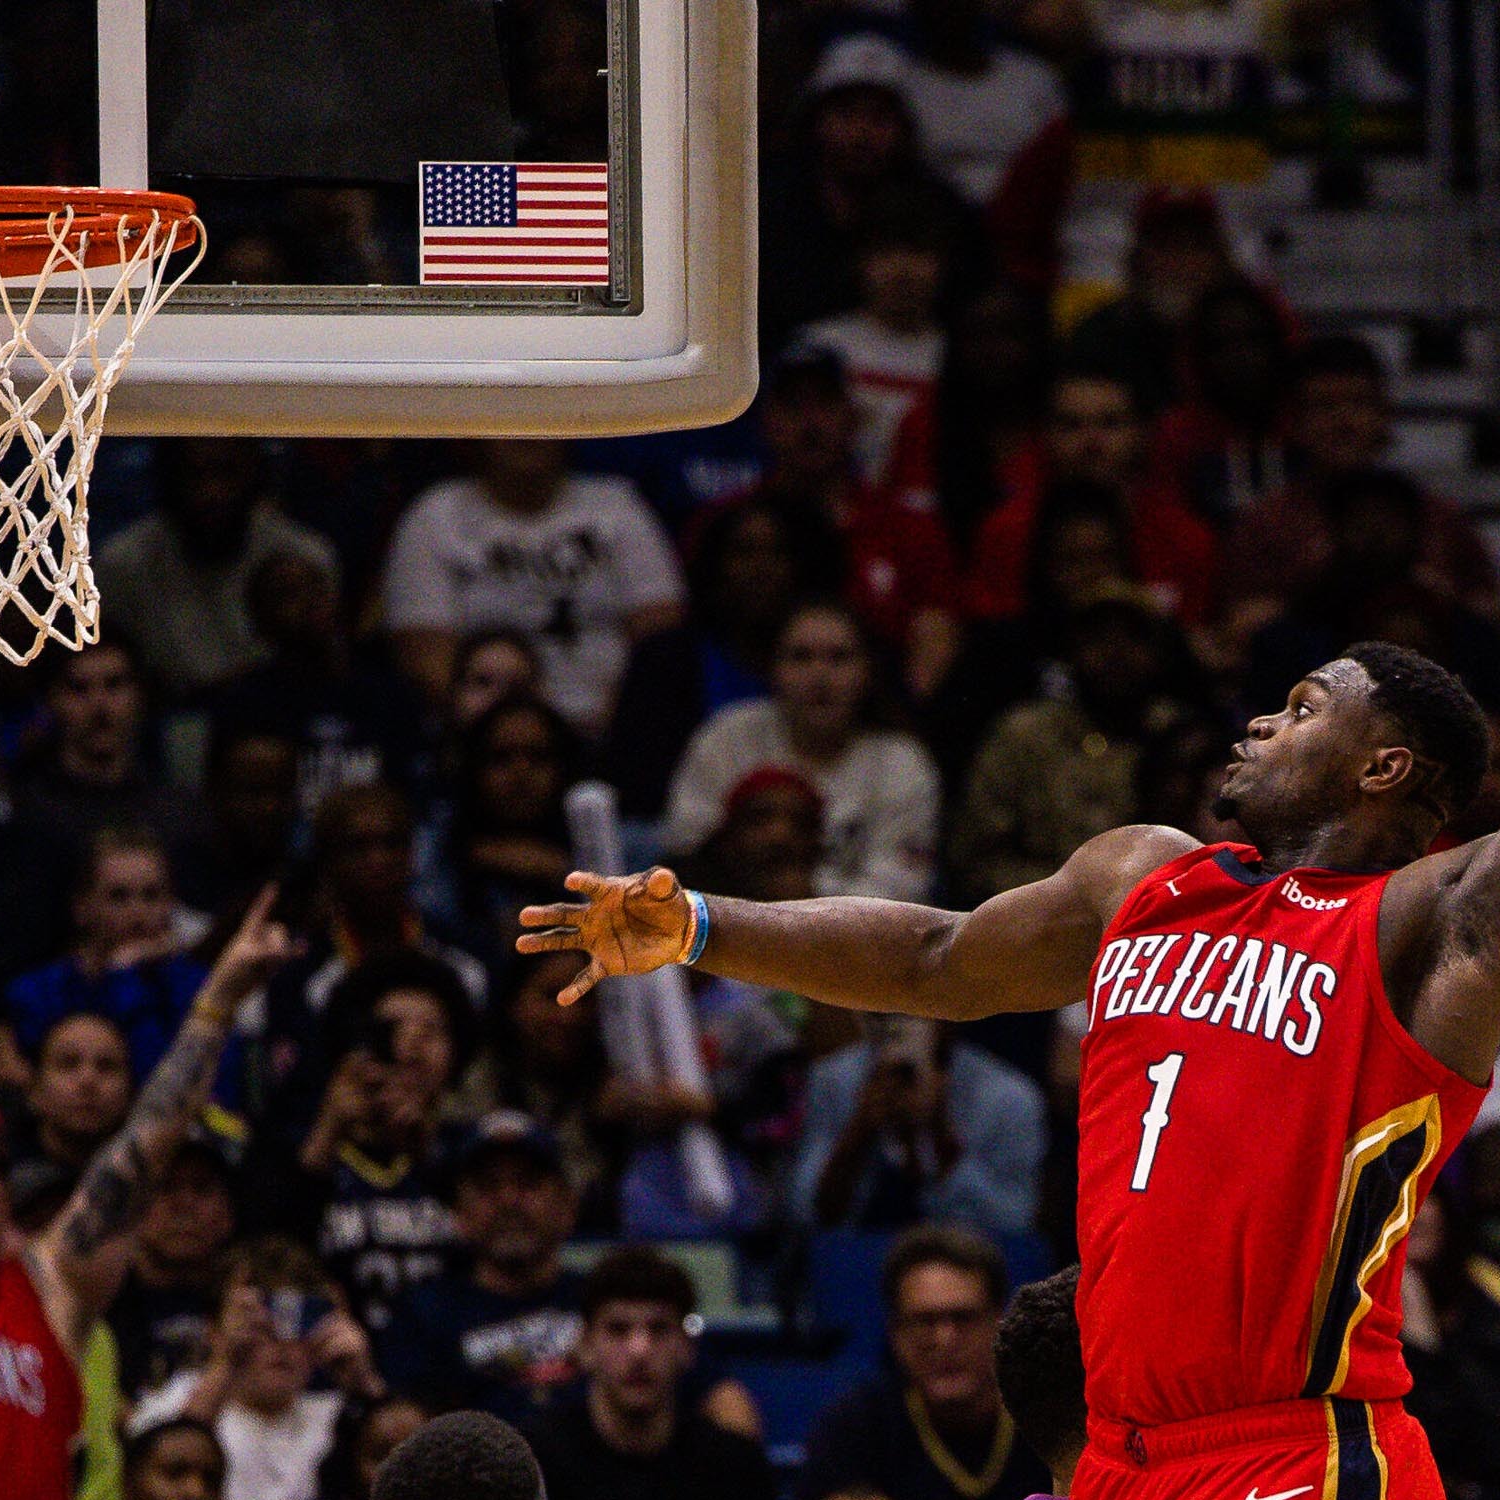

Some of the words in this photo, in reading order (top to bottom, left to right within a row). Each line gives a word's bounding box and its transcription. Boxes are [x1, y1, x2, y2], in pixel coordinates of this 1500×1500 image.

[1280, 877, 1348, 911] ibotta
[1088, 931, 1338, 1057] PELICANS
[1129, 1052, 1186, 1192] 1
